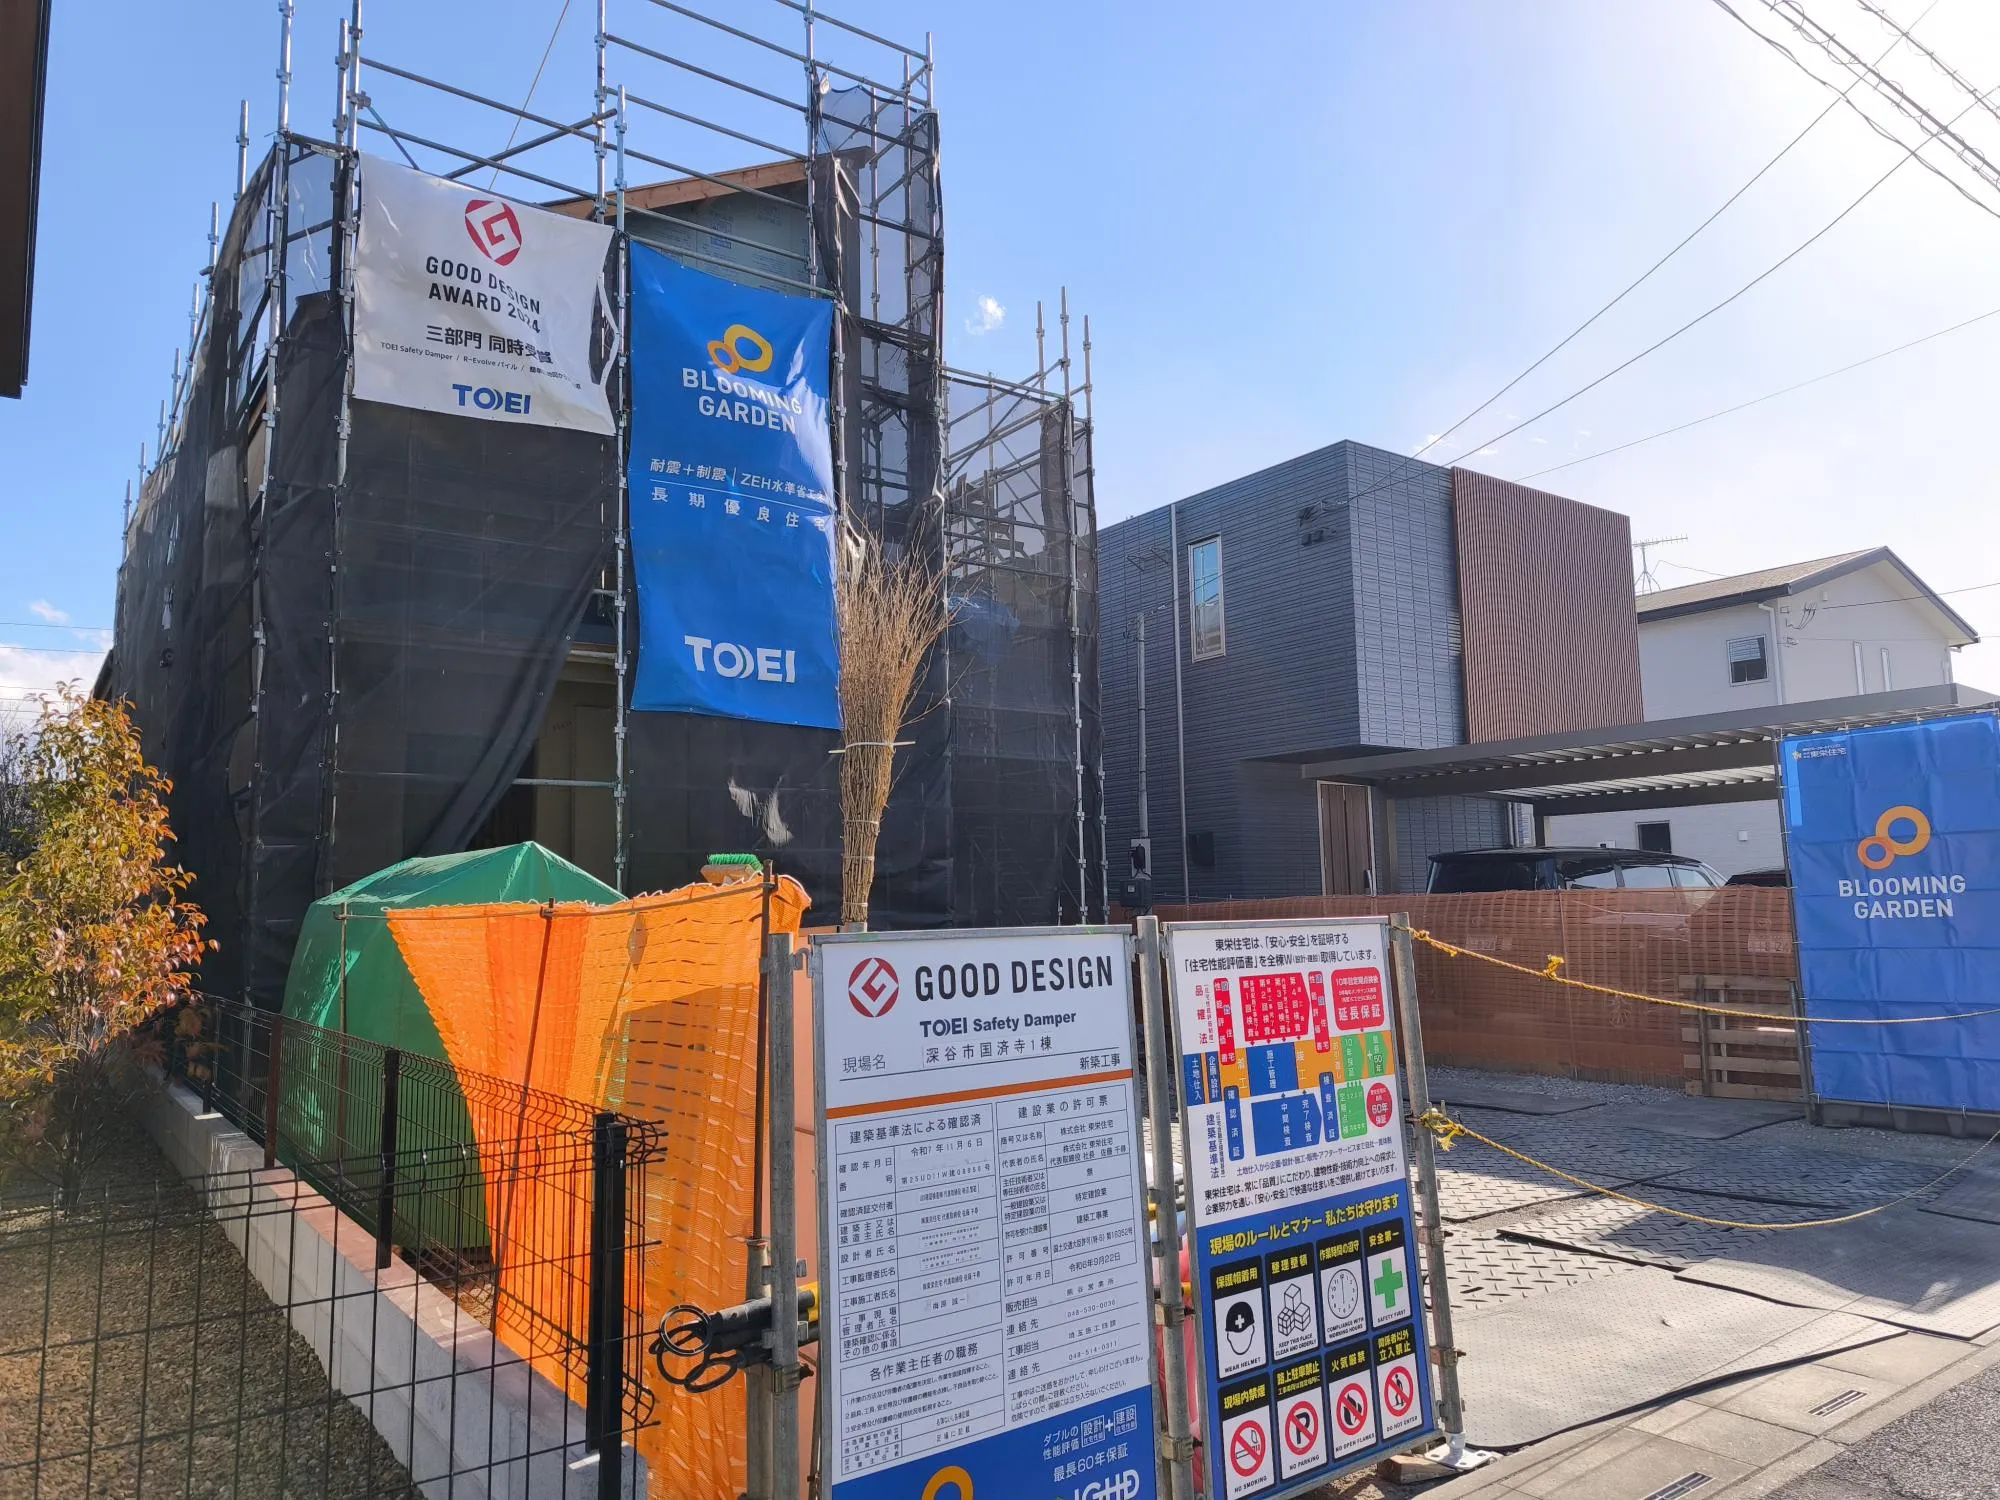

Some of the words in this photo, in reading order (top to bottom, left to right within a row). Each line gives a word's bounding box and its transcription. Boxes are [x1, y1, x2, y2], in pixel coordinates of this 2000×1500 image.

[426, 256, 482, 284] GOOD
[489, 272, 540, 315] DESIGN
[428, 282, 502, 313] AWARD
[507, 302, 541, 333] 2024
[426, 325, 482, 350] 三部門
[381, 342, 399, 351] TOEI
[399, 345, 423, 356] Safety
[424, 349, 453, 361] Damper
[452, 383, 531, 414] TOEI
[682, 368, 802, 415] BLOOMING
[698, 395, 796, 434] GARDEN
[684, 635, 796, 684] TOEI
[1838, 874, 1966, 897] BLOOMING
[1854, 898, 1954, 919] GARDEN
[915, 962, 1000, 1001] GOOD
[1012, 955, 1113, 993] DESIGN
[1338, 1004, 1381, 1021] 延長保証
[920, 1017, 968, 1037] TOEI
[973, 1017, 1020, 1032] Safety
[1024, 1011, 1077, 1028] Damper
[926, 1035, 1053, 1064] 深谷市国済寺1棟
[842, 1053, 886, 1074] 現場名
[1079, 1053, 1121, 1070] 新築工事
[1192, 1057, 1202, 1101] 土地仕入
[1018, 1094, 1108, 1119] 建設業の許可票
[849, 1113, 981, 1145] 建築基準法による確認済
[1302, 1099, 1313, 1142] 完了検査
[1000, 1131, 1042, 1146] 商号又は名称
[1206, 1113, 1220, 1179] 建築基準法
[839, 1157, 893, 1174] 確認年月日
[1210, 1217, 1323, 1256] 現場のルールとマナー
[1325, 1194, 1399, 1227] 私たちは守ります
[1369, 1231, 1400, 1247] 安全第一
[841, 1245, 896, 1263] 設計者氏名
[1271, 1254, 1308, 1274] 整理整頓
[1006, 1269, 1051, 1287] 許可年月日
[1005, 1296, 1038, 1313] 販売担当
[1006, 1318, 1039, 1336] 連絡先
[1008, 1339, 1039, 1358] 工事担当
[1379, 1342, 1411, 1361] 立入禁止
[870, 1342, 979, 1381] 各作業主任者の職務
[1008, 1362, 1040, 1380] 連絡先
[1238, 1357, 1261, 1369] HELMET
[1331, 1351, 1366, 1372] 火気厳禁
[1277, 1361, 1320, 1386] 路上駐車禁止
[1224, 1385, 1266, 1410] 現場内禁煙
[1083, 1419, 1103, 1437] 設計
[1115, 1407, 1135, 1425] 建設
[1043, 1426, 1079, 1447] ダブルの
[1043, 1438, 1080, 1460] 性能評価
[1053, 1442, 1129, 1483] 最長60年保証
[1298, 1454, 1320, 1468] PARKING
[1243, 1475, 1268, 1490] SMOKING
